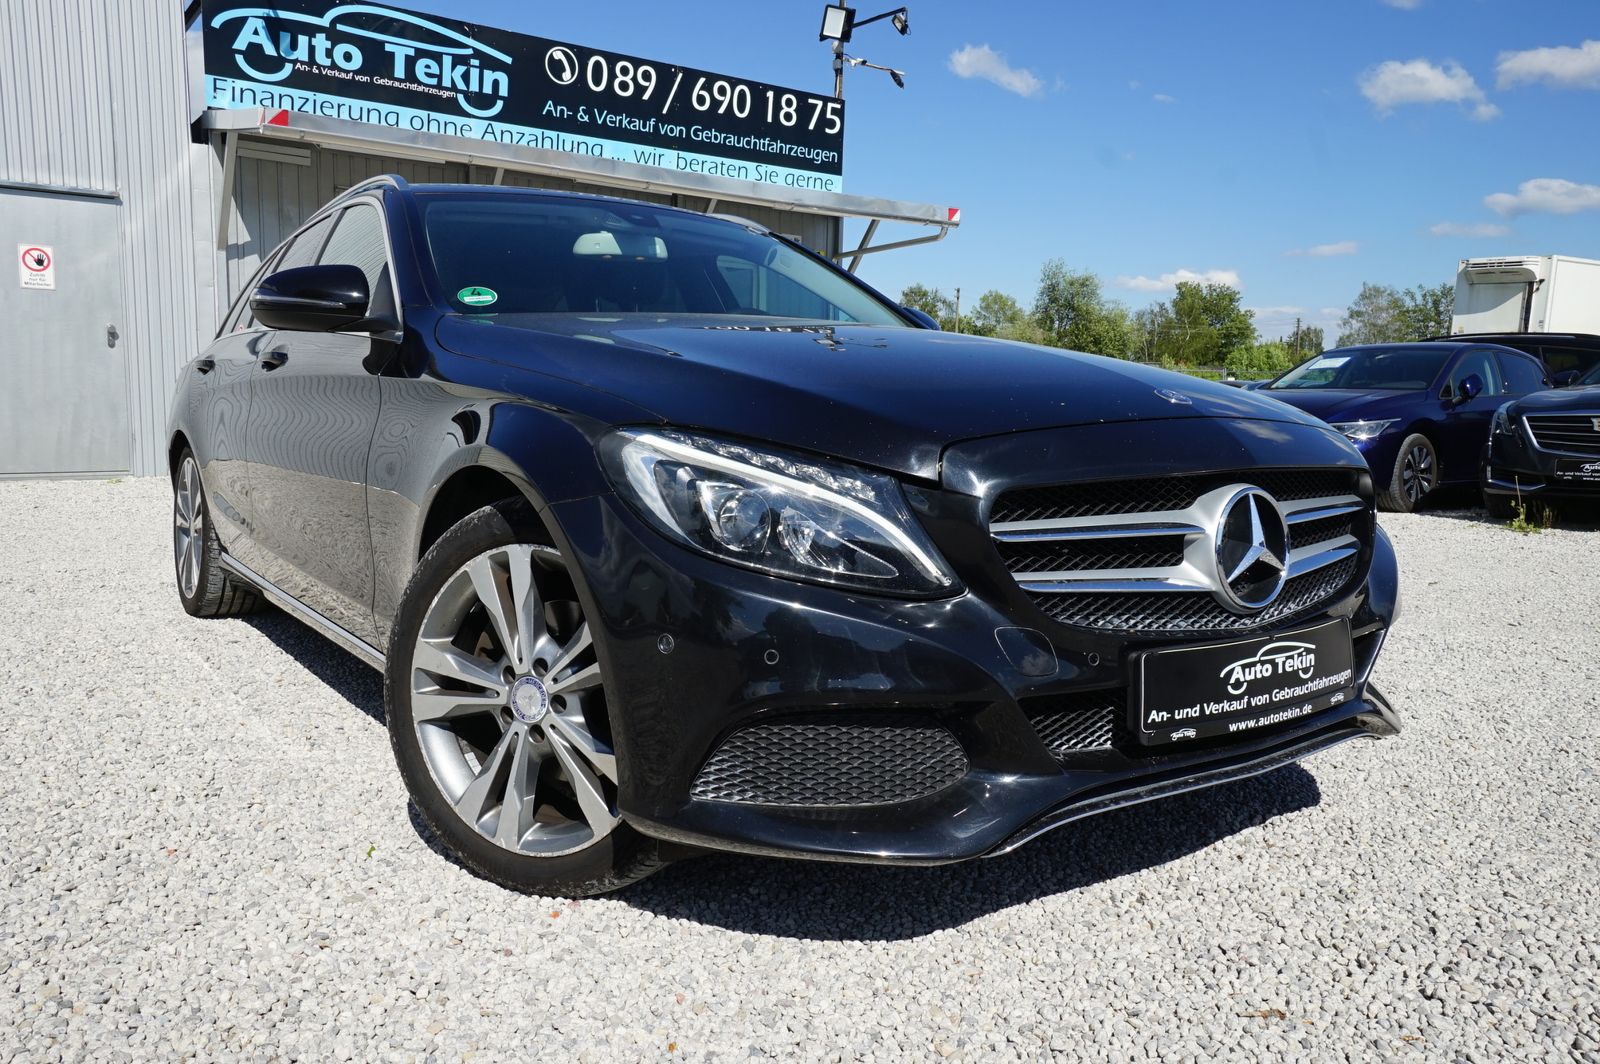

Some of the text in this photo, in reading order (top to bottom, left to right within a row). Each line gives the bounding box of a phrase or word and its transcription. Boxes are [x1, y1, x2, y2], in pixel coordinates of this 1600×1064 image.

[232, 16, 508, 97] Auto Tekin
[295, 62, 456, 98] An- & Verkauf von Gebrauchtfahrzeugen
[586, 55, 842, 134] 089 / 690 18 75
[410, 112, 472, 137] ohne
[634, 147, 665, 167] wir
[676, 152, 748, 180] beraten
[755, 163, 779, 183] Sie
[542, 100, 838, 164] An- & Verkauf von Gebrauchtfahrzeugen
[1147, 709, 1171, 723] An-
[1174, 704, 1200, 719] und
[1203, 696, 1249, 715] Verkauf
[1250, 694, 1269, 706] von
[1272, 669, 1352, 701] Gebrauchtfahrzeugen
[1229, 652, 1315, 684] Auto Tekin
[1229, 704, 1312, 732] www.autotekin.de
